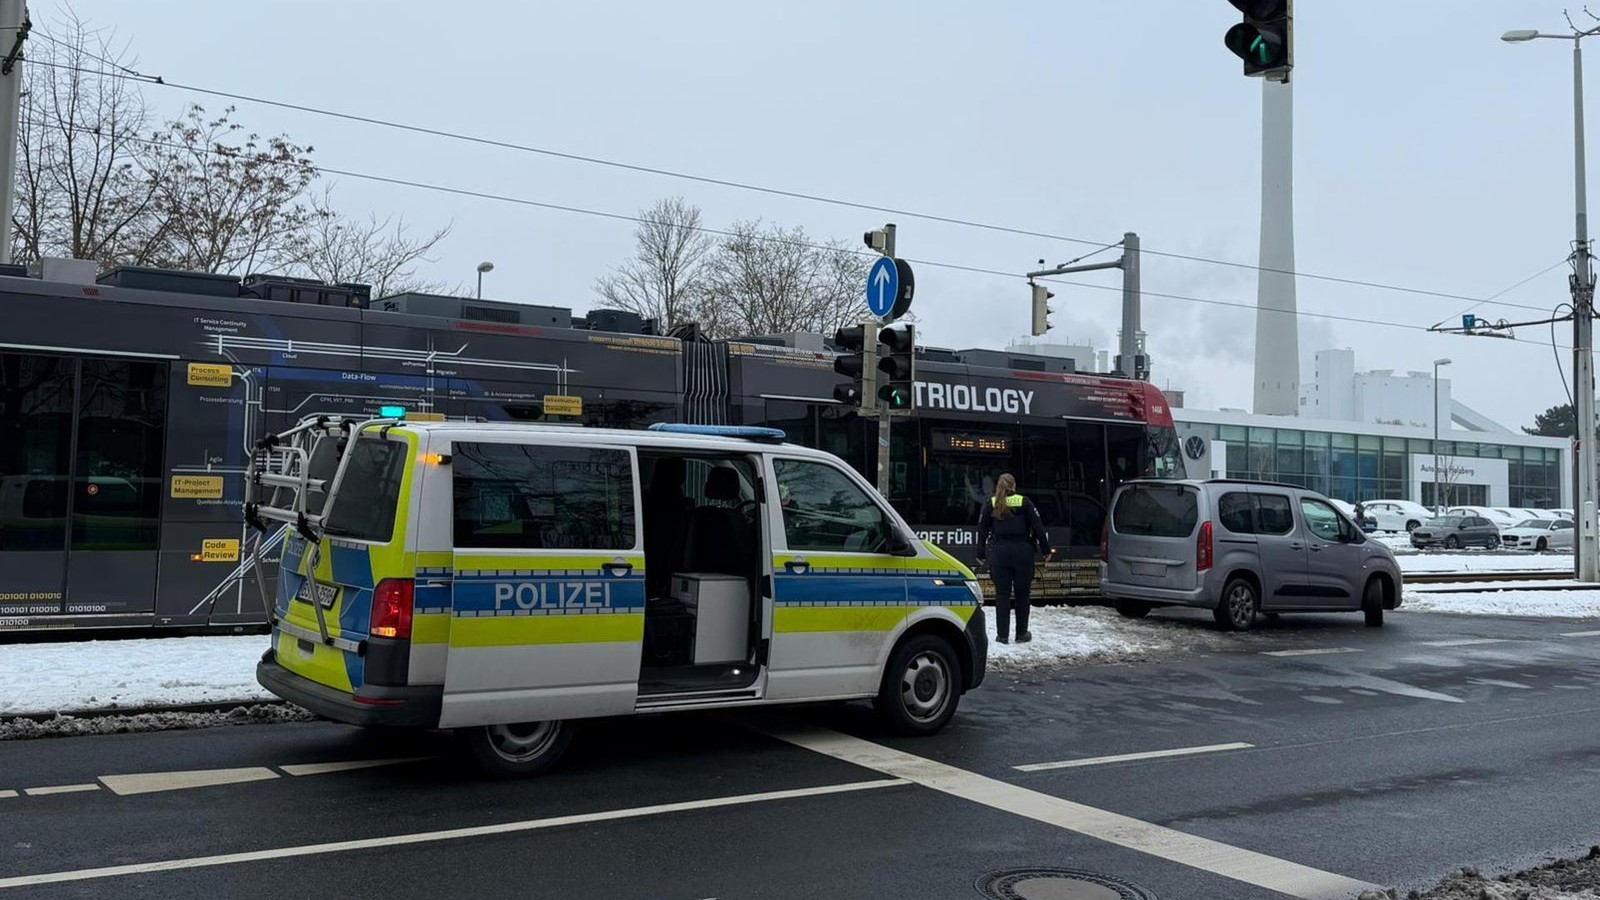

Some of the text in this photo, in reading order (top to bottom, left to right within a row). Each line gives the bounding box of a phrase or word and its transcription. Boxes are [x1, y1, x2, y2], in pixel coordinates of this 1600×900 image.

[200, 317, 219, 325] Service
[203, 325, 238, 333] Management
[191, 366, 220, 374] Process
[190, 374, 229, 384] Consulting
[341, 372, 377, 381] Data-Flow
[914, 382, 1033, 414] TRIOLOGY
[174, 479, 210, 487] IT-Project
[173, 487, 220, 495] Management
[946, 528, 973, 545] FÜR
[204, 541, 226, 549] Code
[204, 550, 235, 559] Review
[495, 582, 611, 610] POLIZEI
